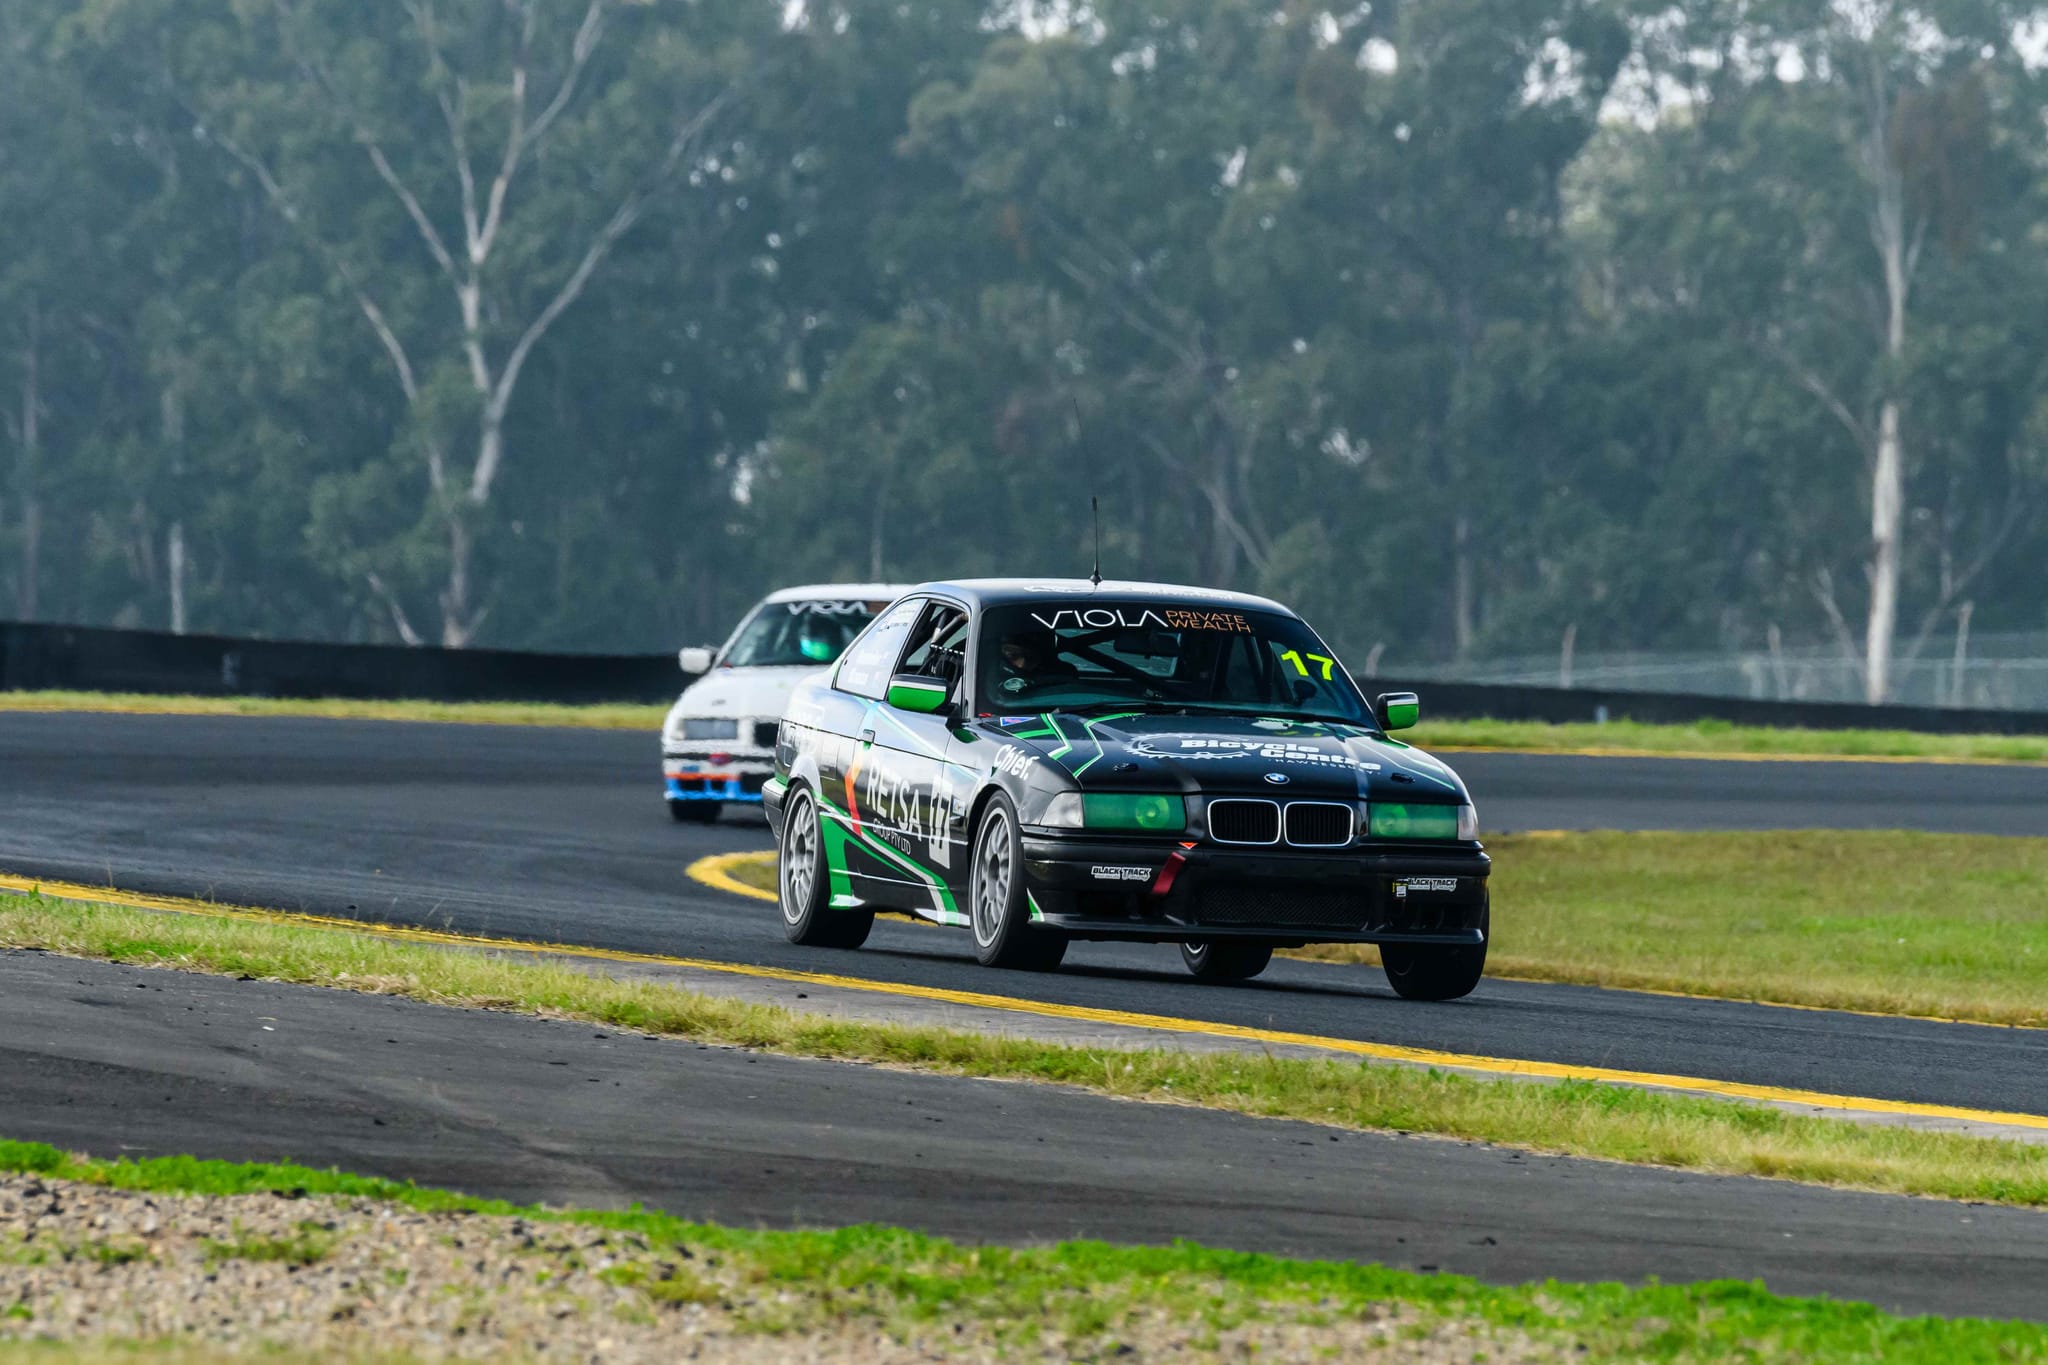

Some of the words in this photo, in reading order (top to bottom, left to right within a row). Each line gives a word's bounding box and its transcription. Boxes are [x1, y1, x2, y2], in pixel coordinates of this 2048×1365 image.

[1031, 610, 1169, 629] VIOLA
[1165, 610, 1246, 625] PRIVATE
[1168, 619, 1252, 634] WEALTH
[1281, 649, 1334, 681] 17
[1180, 739, 1321, 753] Bicycle
[866, 758, 923, 842] RETSA
[1091, 866, 1121, 875] BLACK
